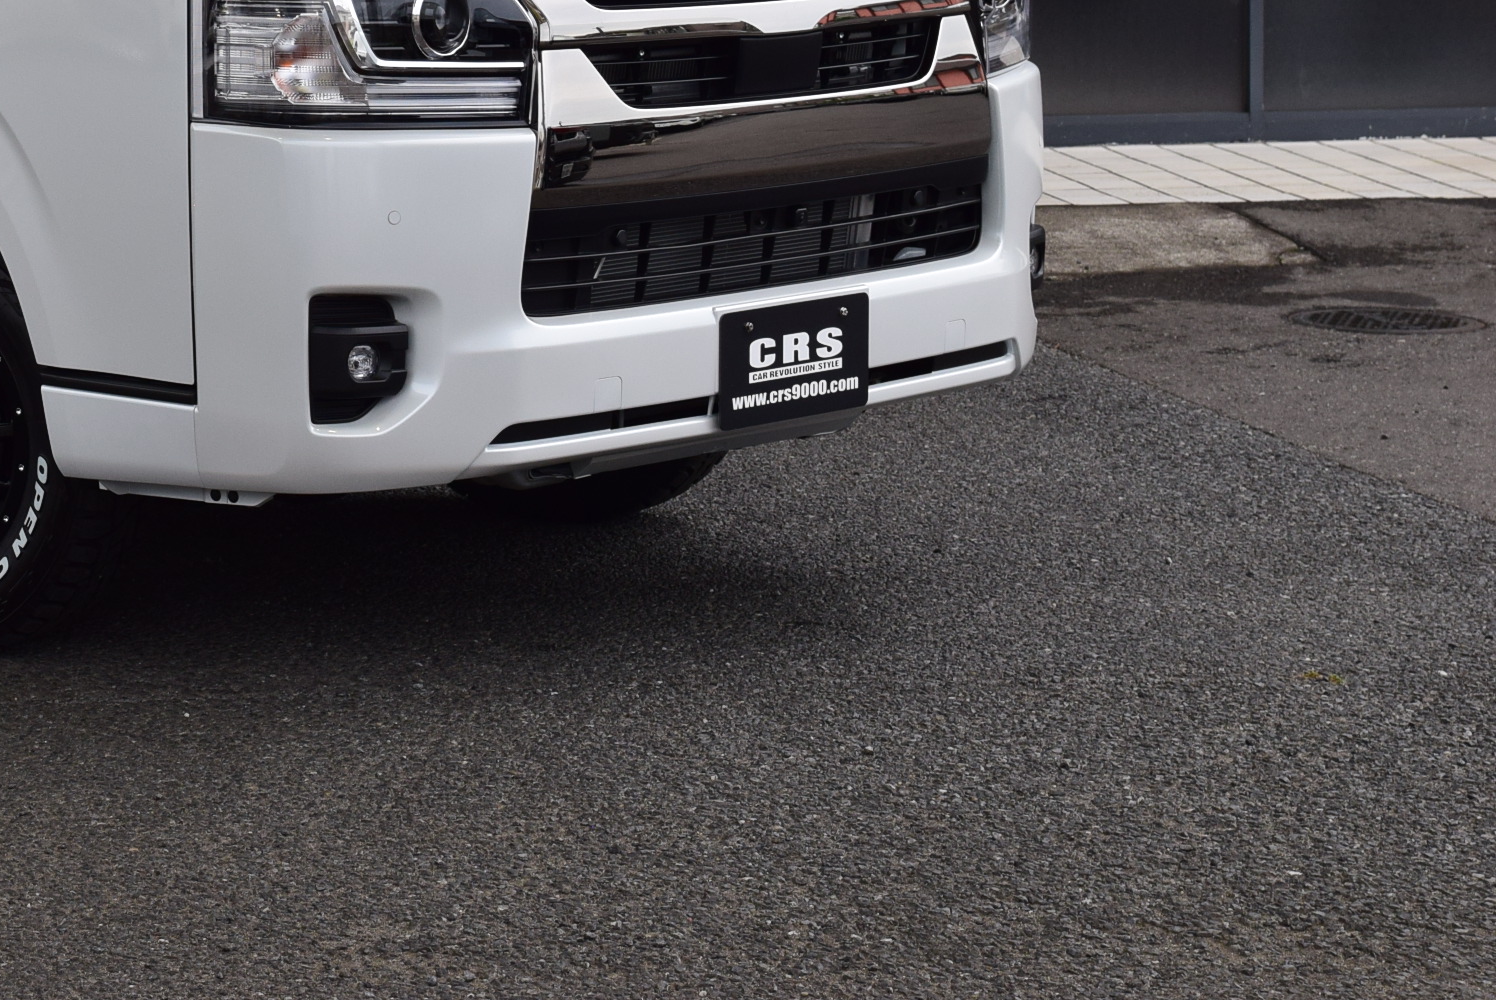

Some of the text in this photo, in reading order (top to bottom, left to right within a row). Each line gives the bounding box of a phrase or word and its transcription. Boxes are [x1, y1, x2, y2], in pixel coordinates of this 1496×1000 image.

[749, 327, 843, 368] CRS
[752, 360, 840, 381] CAR REVOLUTION STYLE
[732, 376, 859, 410] www.crs9000.com
[11, 455, 47, 559] OPEN
